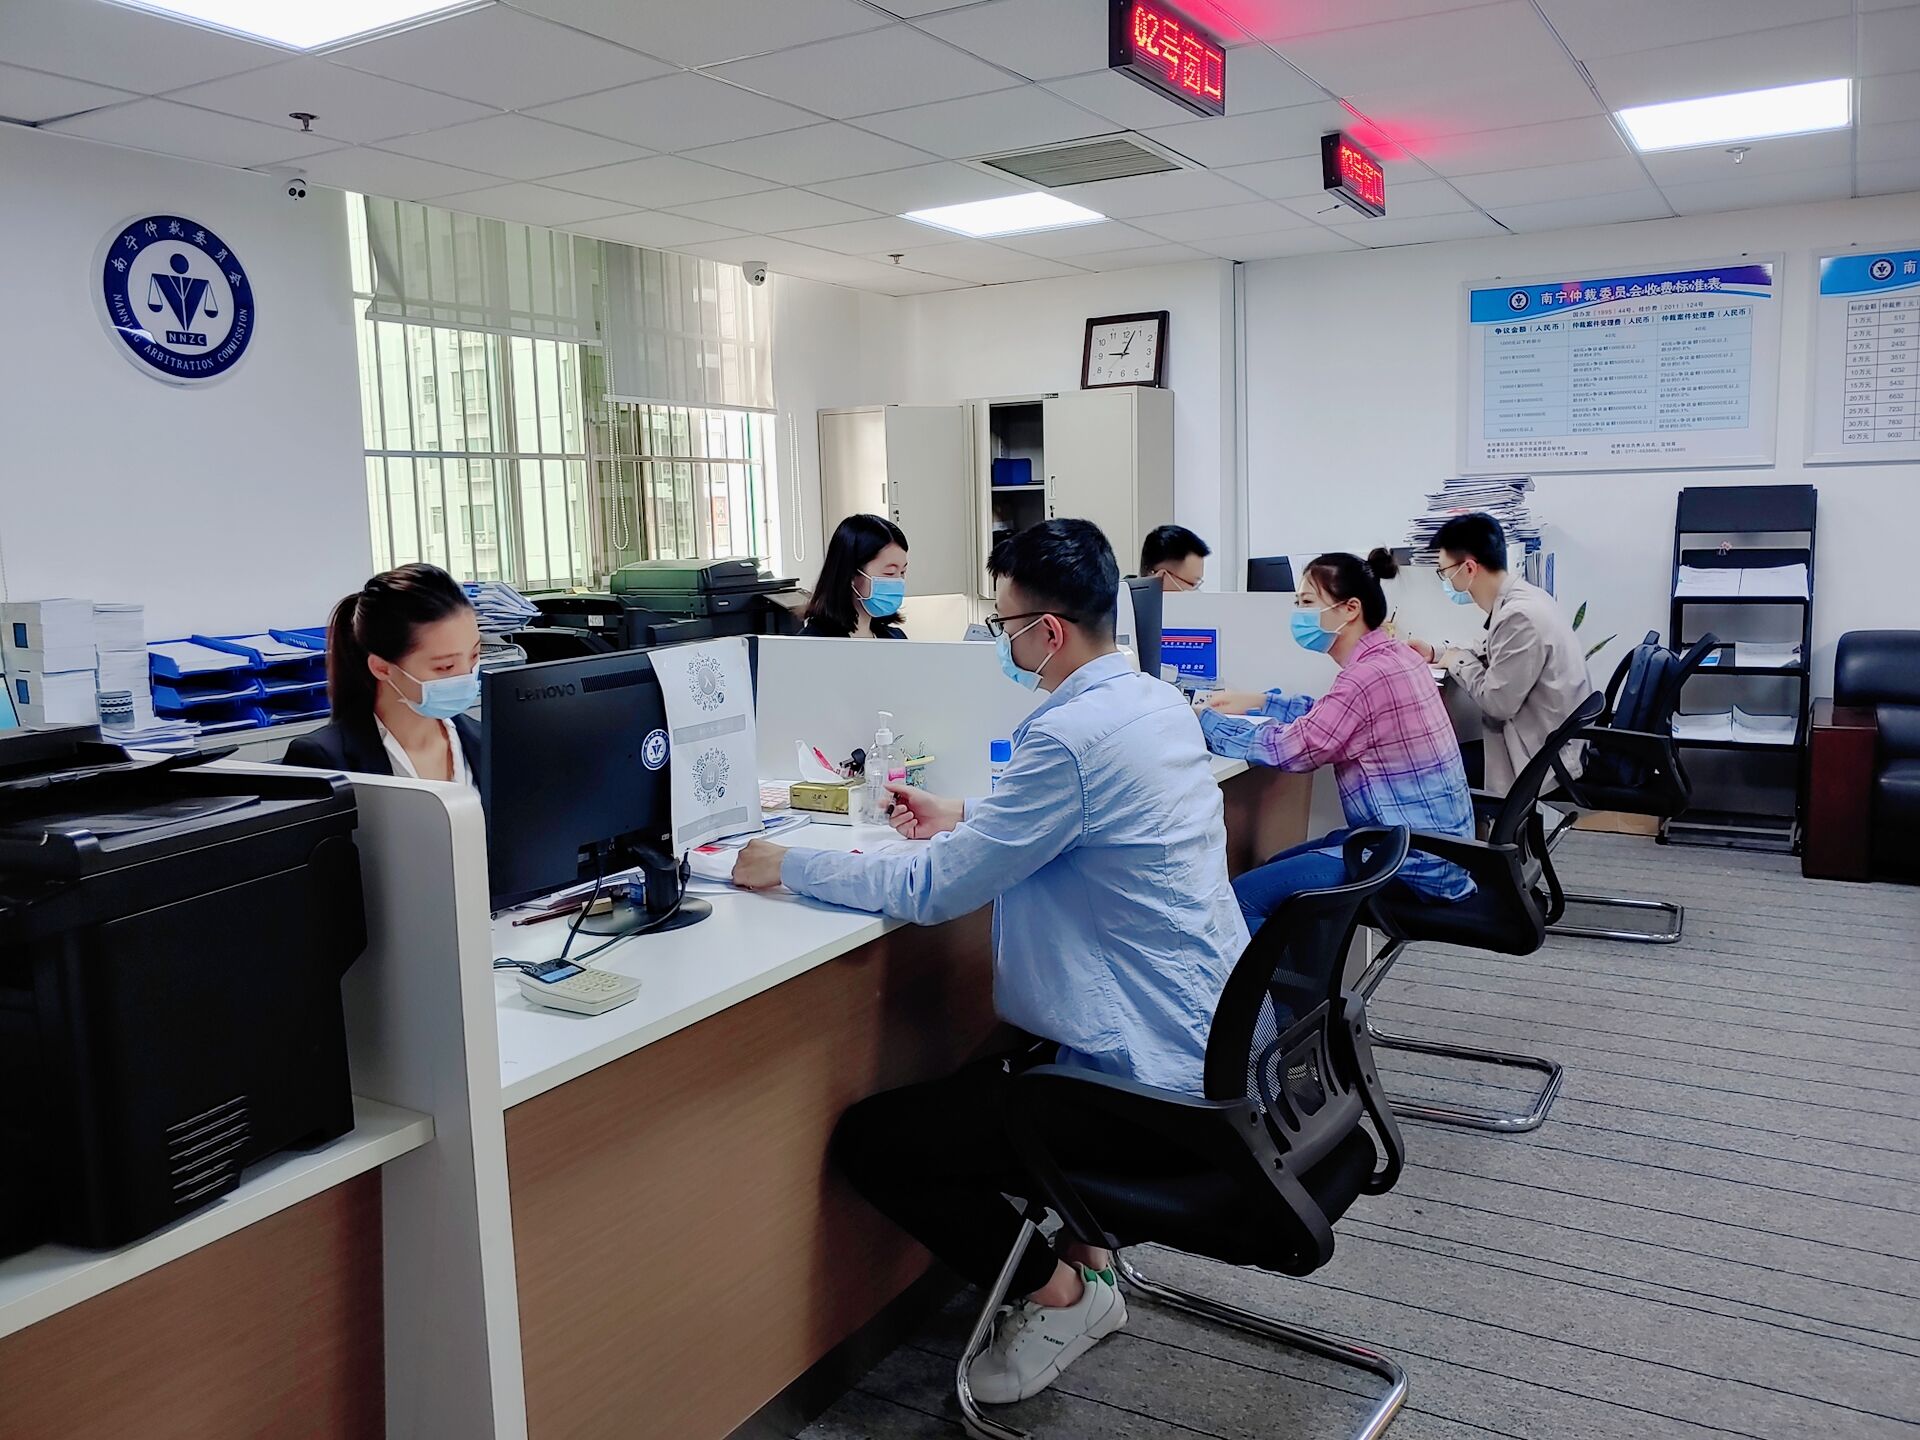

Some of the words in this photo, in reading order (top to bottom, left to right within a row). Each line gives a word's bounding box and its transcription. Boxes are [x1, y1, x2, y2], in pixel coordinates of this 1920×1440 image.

[1134, 6, 1222, 100] 02号窗口
[111, 220, 242, 287] 南宁仲裁委员会
[1903, 260, 1917, 274] 南
[1541, 276, 1721, 305] 南宁仲裁委员会收费标准表
[113, 293, 140, 343] NANNIG
[144, 344, 214, 371] ARBITRATION
[218, 308, 248, 362] COMMISSION
[169, 333, 205, 345] NNZC
[515, 683, 576, 701] Lenovo
